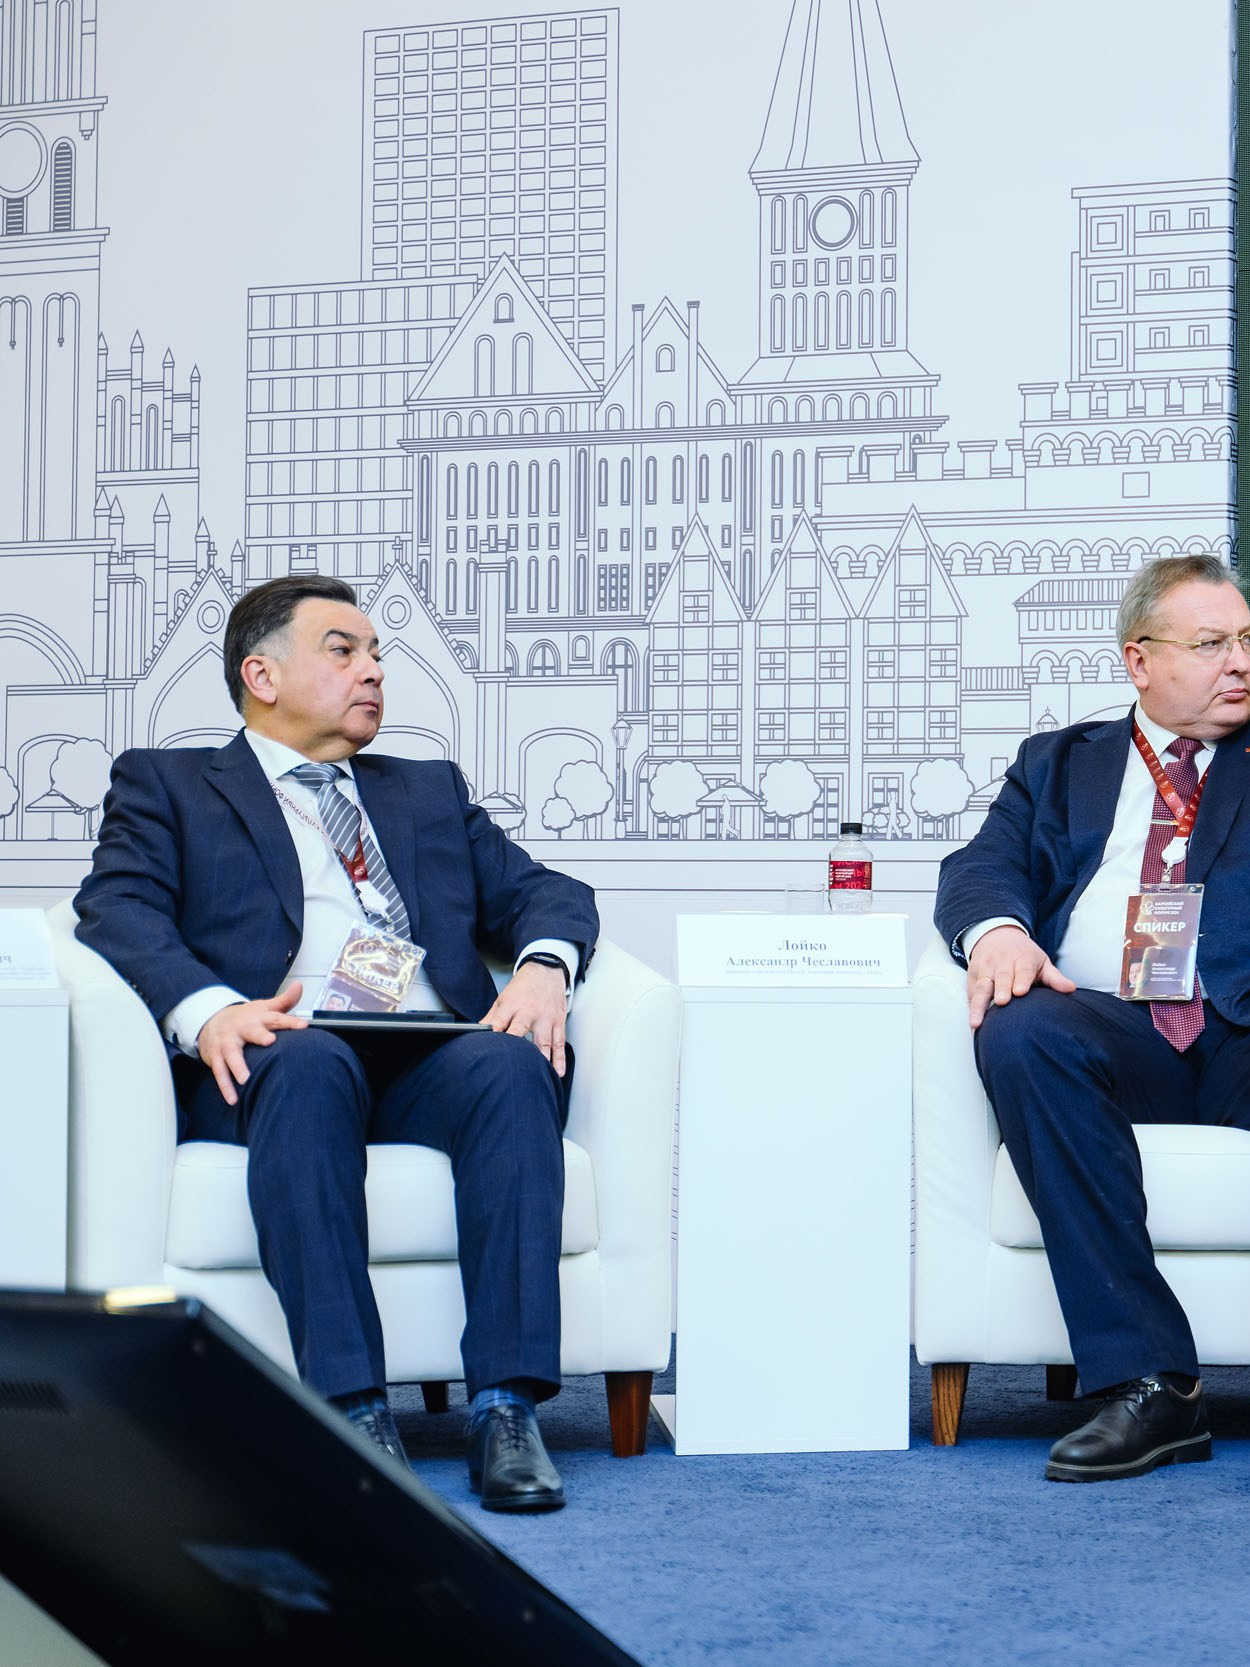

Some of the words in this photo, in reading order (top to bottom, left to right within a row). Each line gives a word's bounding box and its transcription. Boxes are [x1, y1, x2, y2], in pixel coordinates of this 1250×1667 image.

[1133, 921, 1187, 933] СПИКЕР
[778, 939, 827, 951] Лойко
[726, 956, 798, 968] Александр
[802, 956, 881, 967] Чеславович
